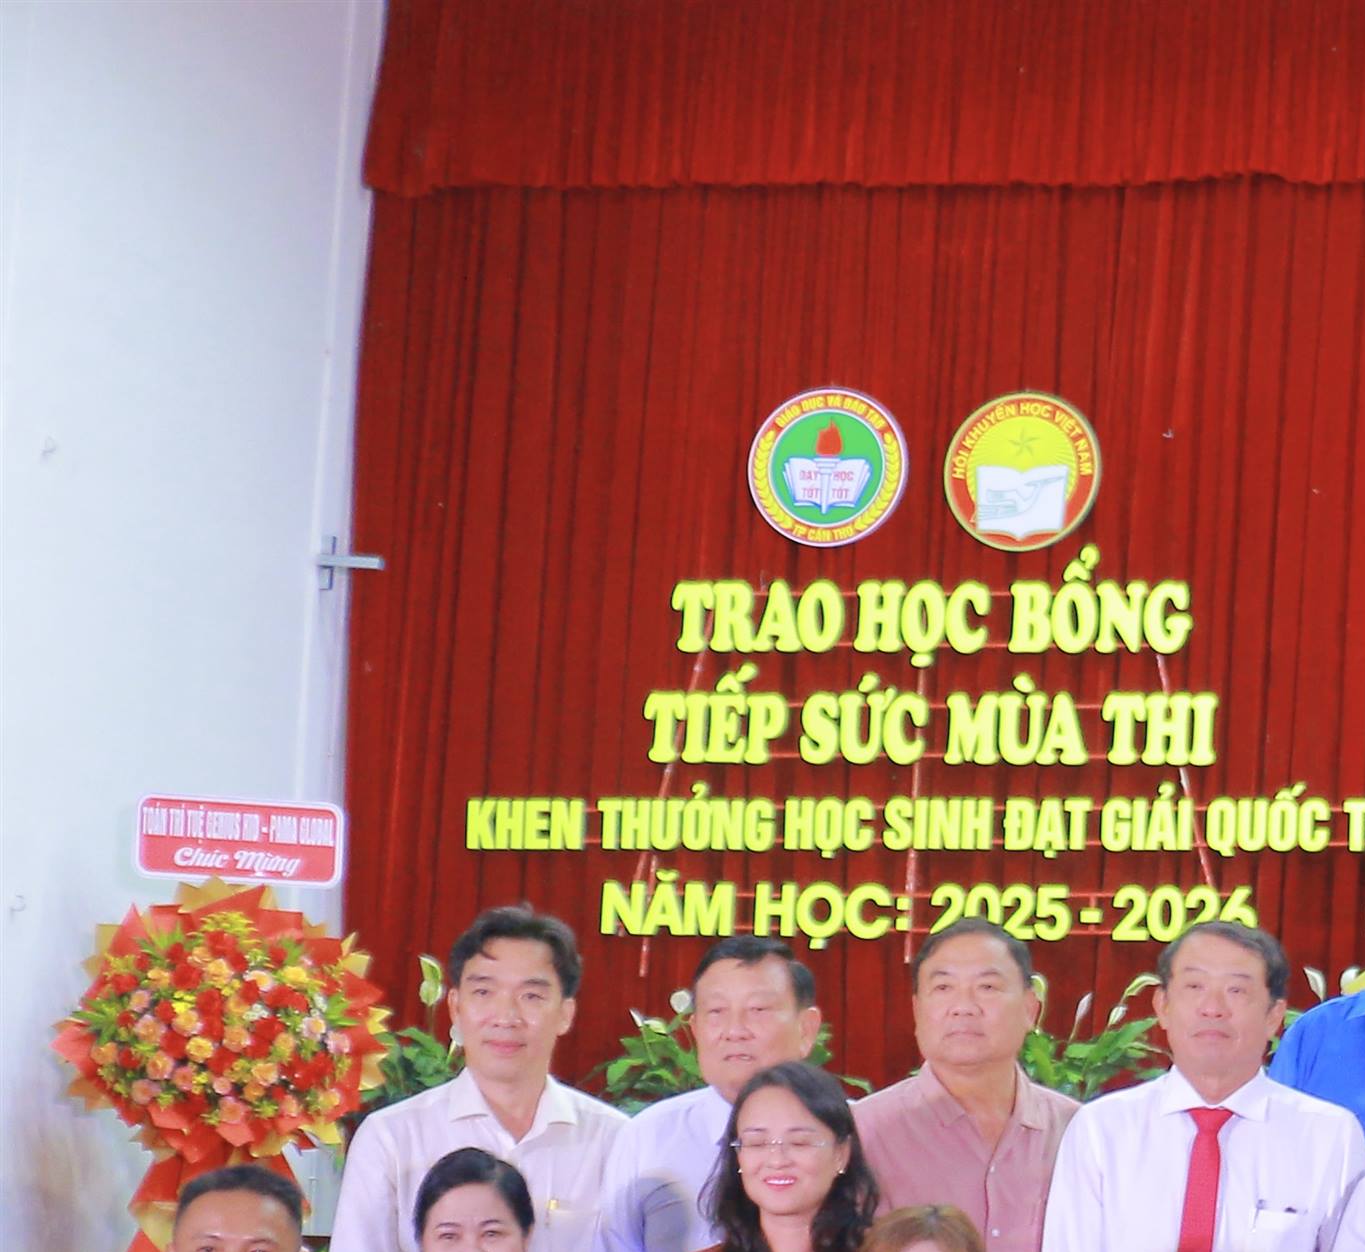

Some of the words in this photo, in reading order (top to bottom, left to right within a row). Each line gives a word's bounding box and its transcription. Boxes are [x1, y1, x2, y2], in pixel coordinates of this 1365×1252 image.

[826, 393, 842, 409] VÀ
[951, 449, 969, 480] HỘI
[964, 402, 1017, 449] KHUYẾN
[1019, 401, 1052, 420] HỌC
[1053, 408, 1081, 441] VIỆT
[1075, 436, 1093, 477] NAM
[671, 578, 844, 653] TRAO
[853, 578, 991, 668] HỌC
[1008, 543, 1193, 654] BỔNG
[644, 662, 789, 765] TIẾP
[800, 672, 929, 765] SỨC
[944, 672, 1088, 766] MÙA
[1102, 691, 1218, 766] THI
[466, 796, 585, 851] KHEN
[597, 782, 775, 850] THƯỞNG
[784, 796, 876, 858] HỌC
[883, 796, 993, 851] SINH
[1003, 796, 1091, 858] ĐẠT
[1100, 781, 1195, 852] GIẢI
[1205, 782, 1332, 857] QUỐC
[174, 846, 230, 868] Chúc
[234, 849, 300, 877] Mừng
[600, 868, 736, 937] NĂM
[753, 880, 912, 949] HỌC:
[1079, 906, 1103, 925] -
